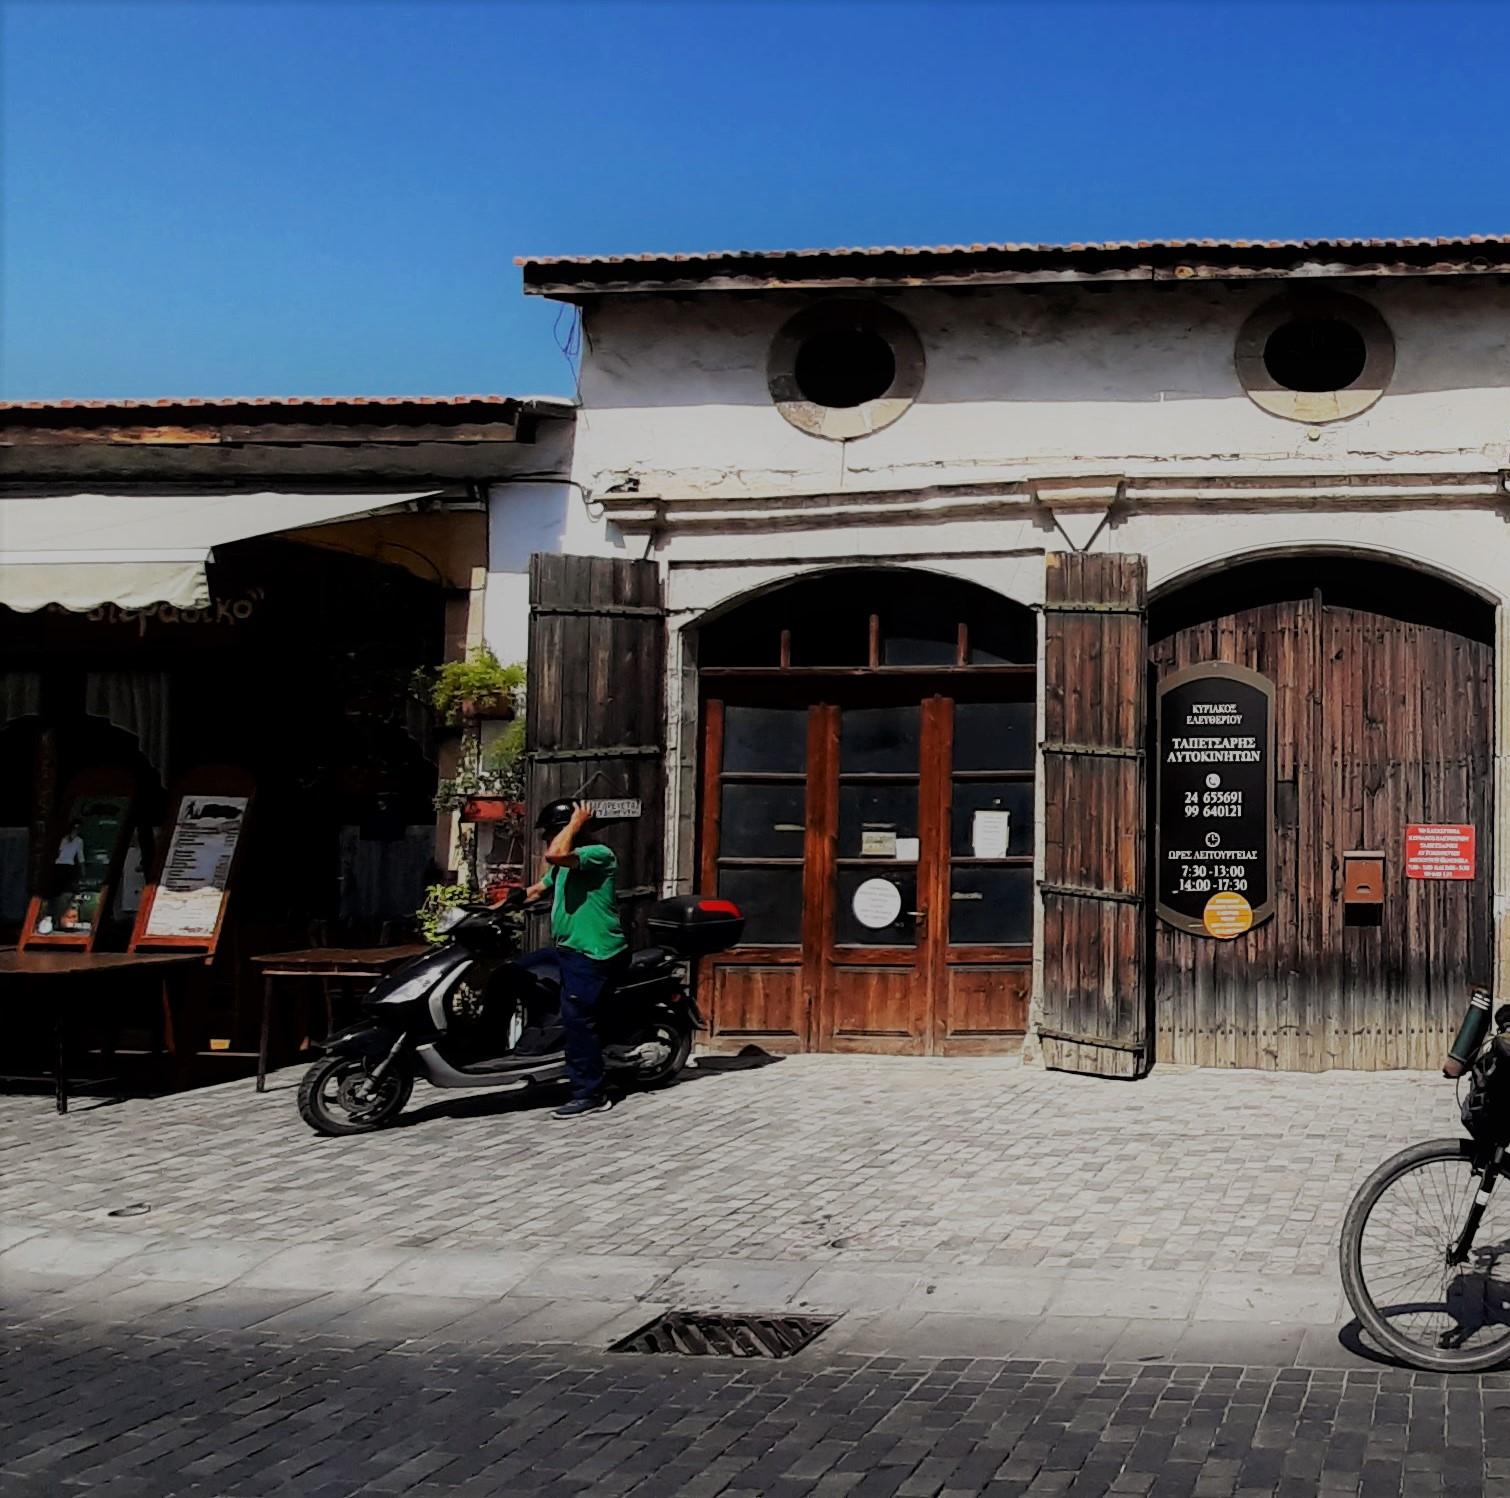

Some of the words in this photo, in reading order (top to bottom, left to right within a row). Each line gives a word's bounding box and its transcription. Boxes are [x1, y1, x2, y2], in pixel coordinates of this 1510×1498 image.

[1186, 714, 1243, 725] ΕΛΕΥΘΕΡΙΟΥ
[1171, 737, 1256, 749] ΤΑΠΕΤΣΑΡΗΣ
[1166, 750, 1261, 763] ΑΥΤΟΚΙΝΗΤΩΝ
[1184, 791, 1199, 803] 24
[1202, 791, 1243, 803] 655691
[1184, 805, 1199, 817] 99
[1202, 805, 1242, 817] 640121
[1168, 850, 1192, 860] ΩΡΕΣ
[1181, 865, 1207, 877] 7:30
[1179, 879, 1211, 891] 14:00
